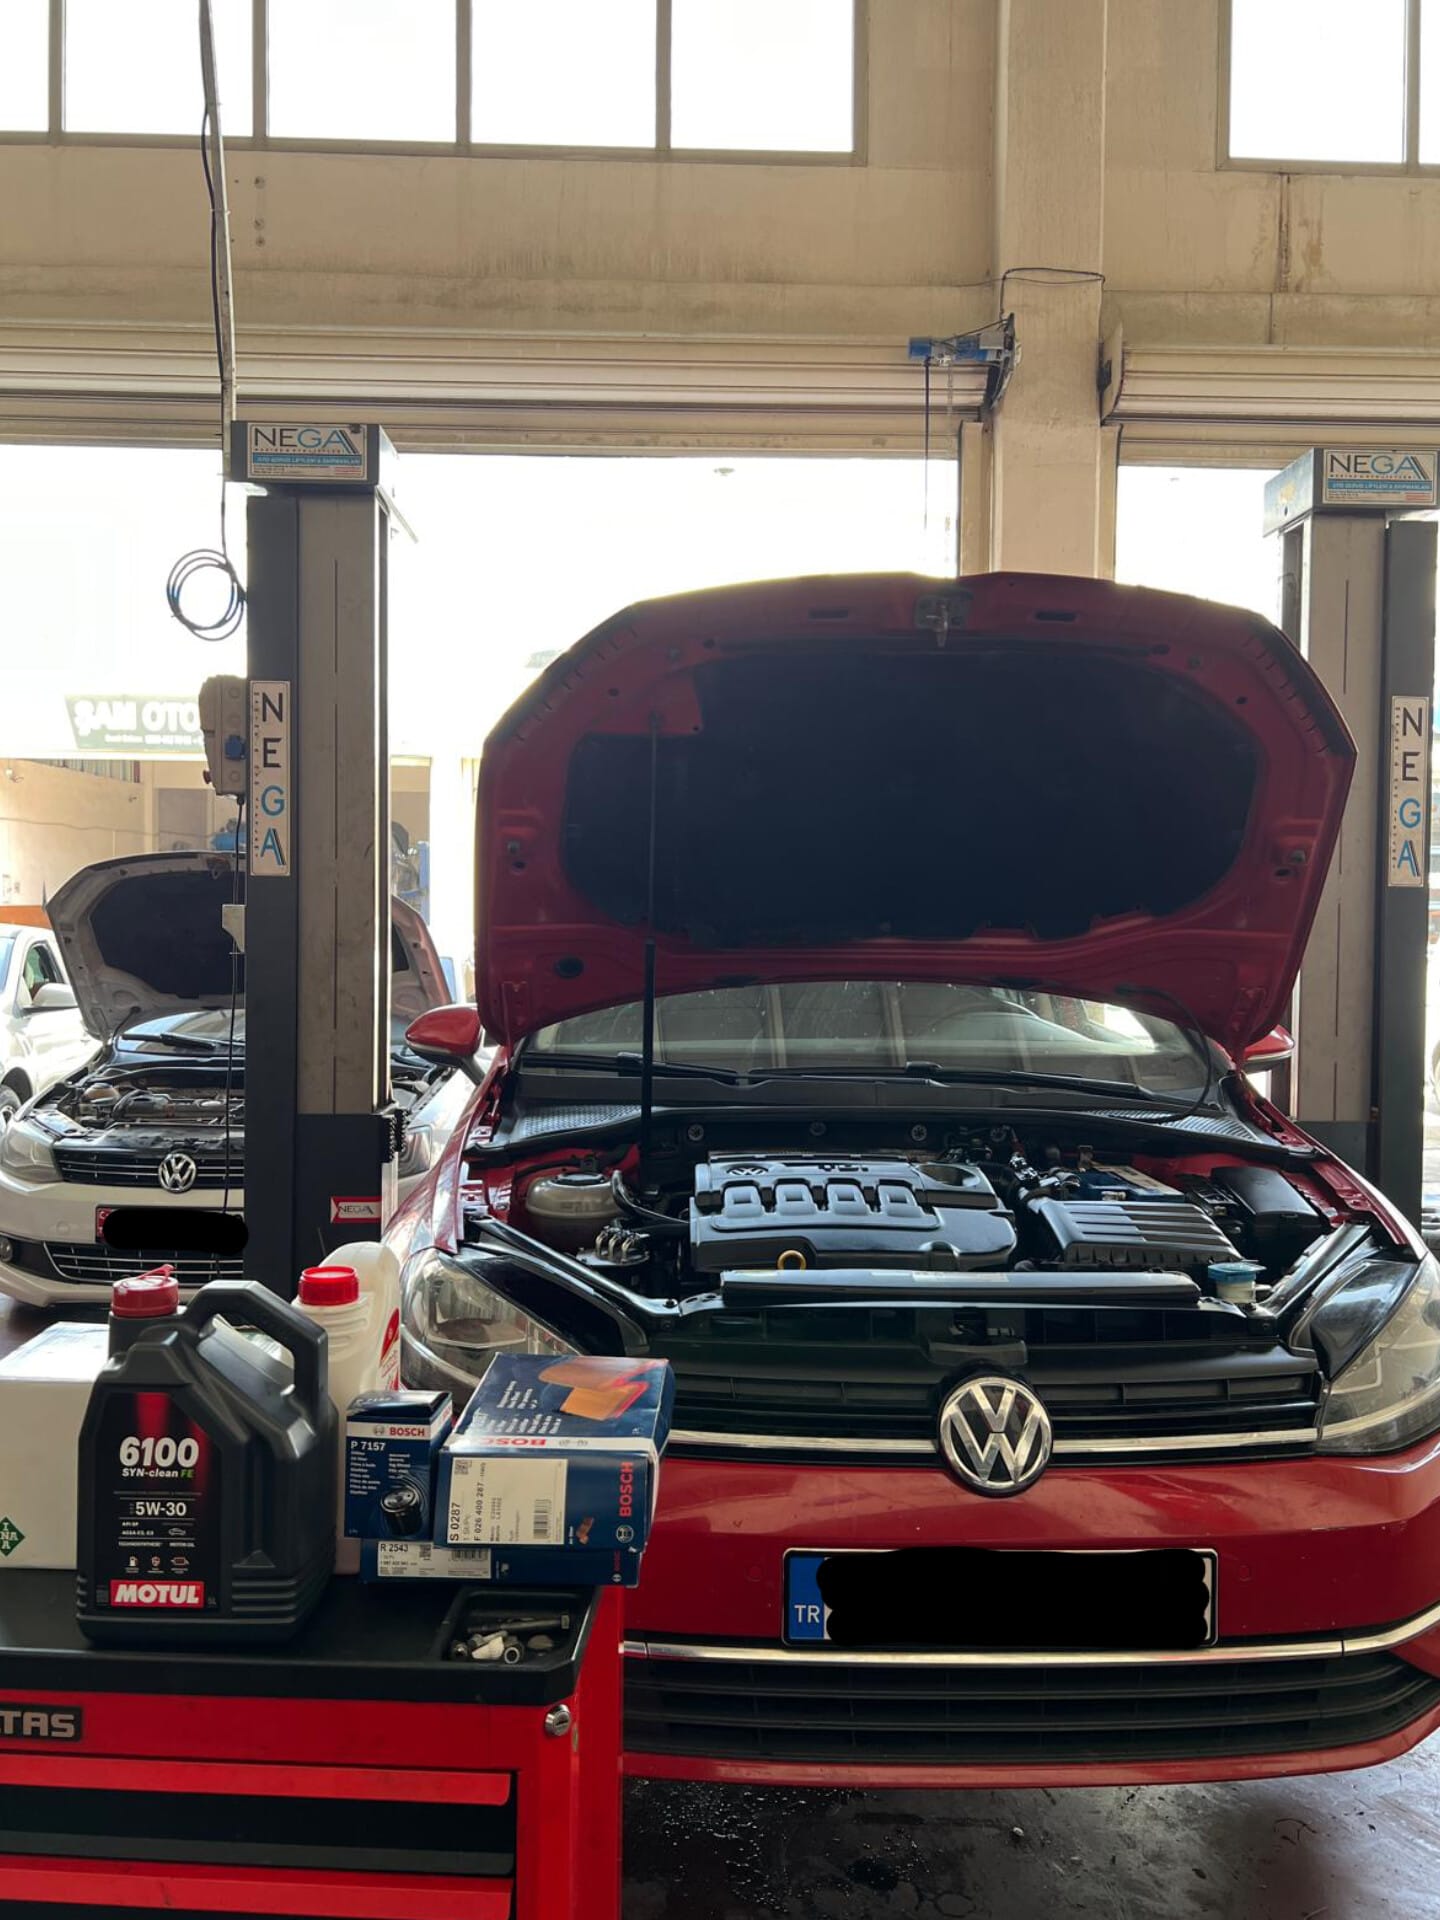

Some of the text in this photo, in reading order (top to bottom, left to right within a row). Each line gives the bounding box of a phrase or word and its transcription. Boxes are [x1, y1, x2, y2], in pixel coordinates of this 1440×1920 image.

[254, 428, 358, 454] NEGA
[1330, 453, 1429, 480] NEGA
[142, 701, 199, 732] OTO
[261, 692, 287, 866] NEGA
[1397, 707, 1422, 877] NEGA
[389, 1427, 426, 1437] BOSCH
[120, 1436, 199, 1468] 6100
[351, 1441, 386, 1451] P 7157
[122, 1468, 178, 1478] SYN-clean
[619, 1461, 634, 1517] BOSCH
[135, 1501, 187, 1517] 5W-30
[450, 1502, 461, 1541] S 0287
[380, 1543, 408, 1552] R 2543
[115, 1584, 199, 1604] MOTUL
[794, 1604, 820, 1623] TR
[0, 1710, 75, 1738] TAS
